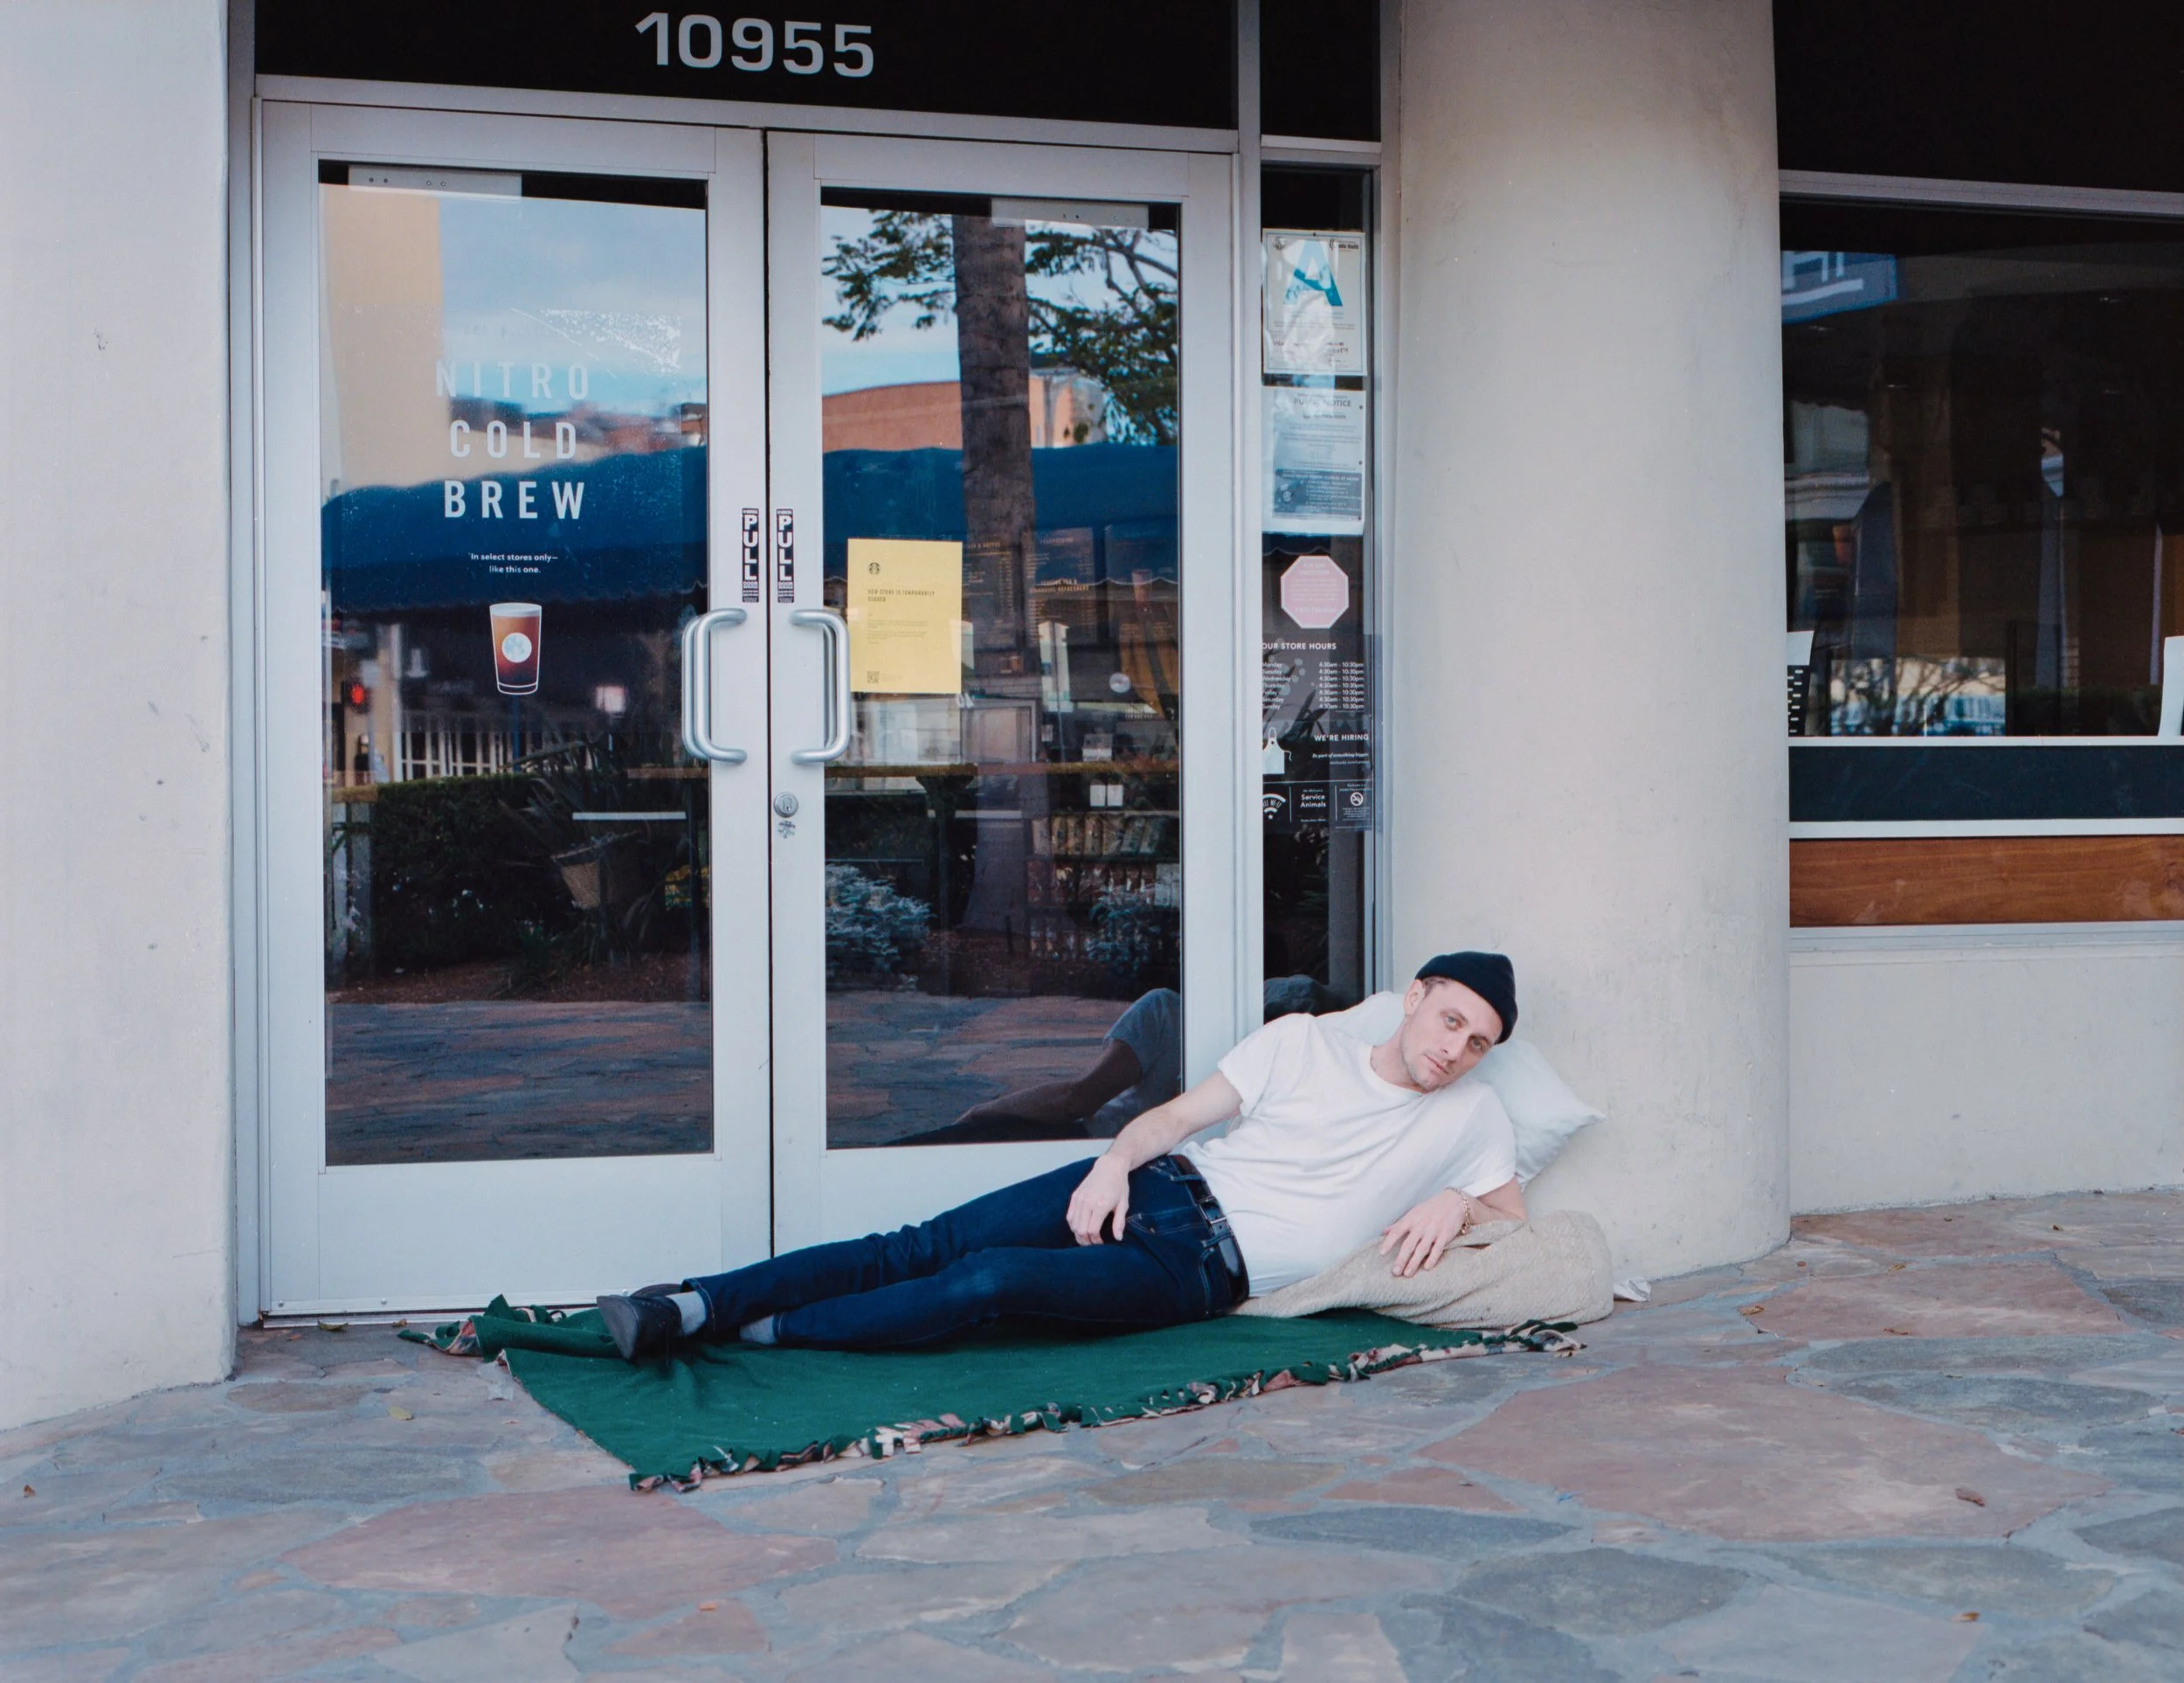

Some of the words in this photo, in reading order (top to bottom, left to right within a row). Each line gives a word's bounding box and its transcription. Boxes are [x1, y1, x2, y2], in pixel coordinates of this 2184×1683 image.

[634, 11, 874, 78] 10955
[1283, 239, 1344, 307] A
[436, 360, 589, 400] NITRO
[450, 419, 577, 460] COLD
[444, 480, 584, 519] BREW
[743, 514, 758, 581] PULL
[778, 515, 793, 581] PULL
